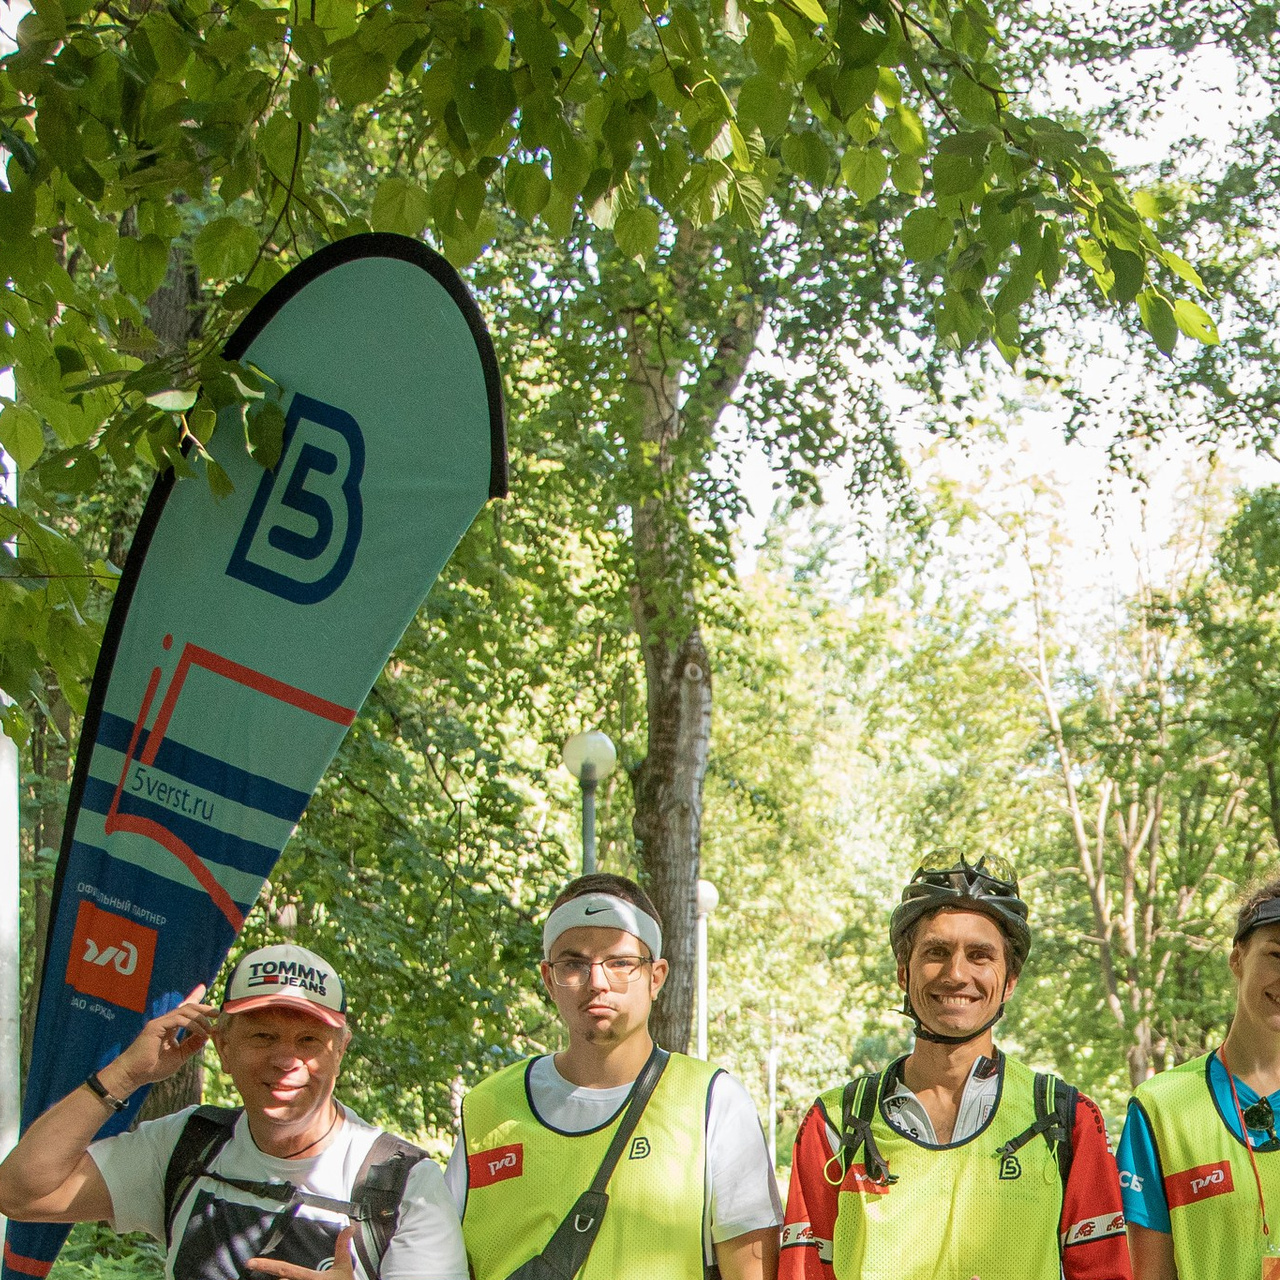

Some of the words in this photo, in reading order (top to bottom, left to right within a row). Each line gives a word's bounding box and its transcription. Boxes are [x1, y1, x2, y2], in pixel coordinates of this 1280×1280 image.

[131, 767, 215, 822] 5verst.ru
[249, 960, 329, 985] TOMMY
[280, 975, 327, 997] JEANS
